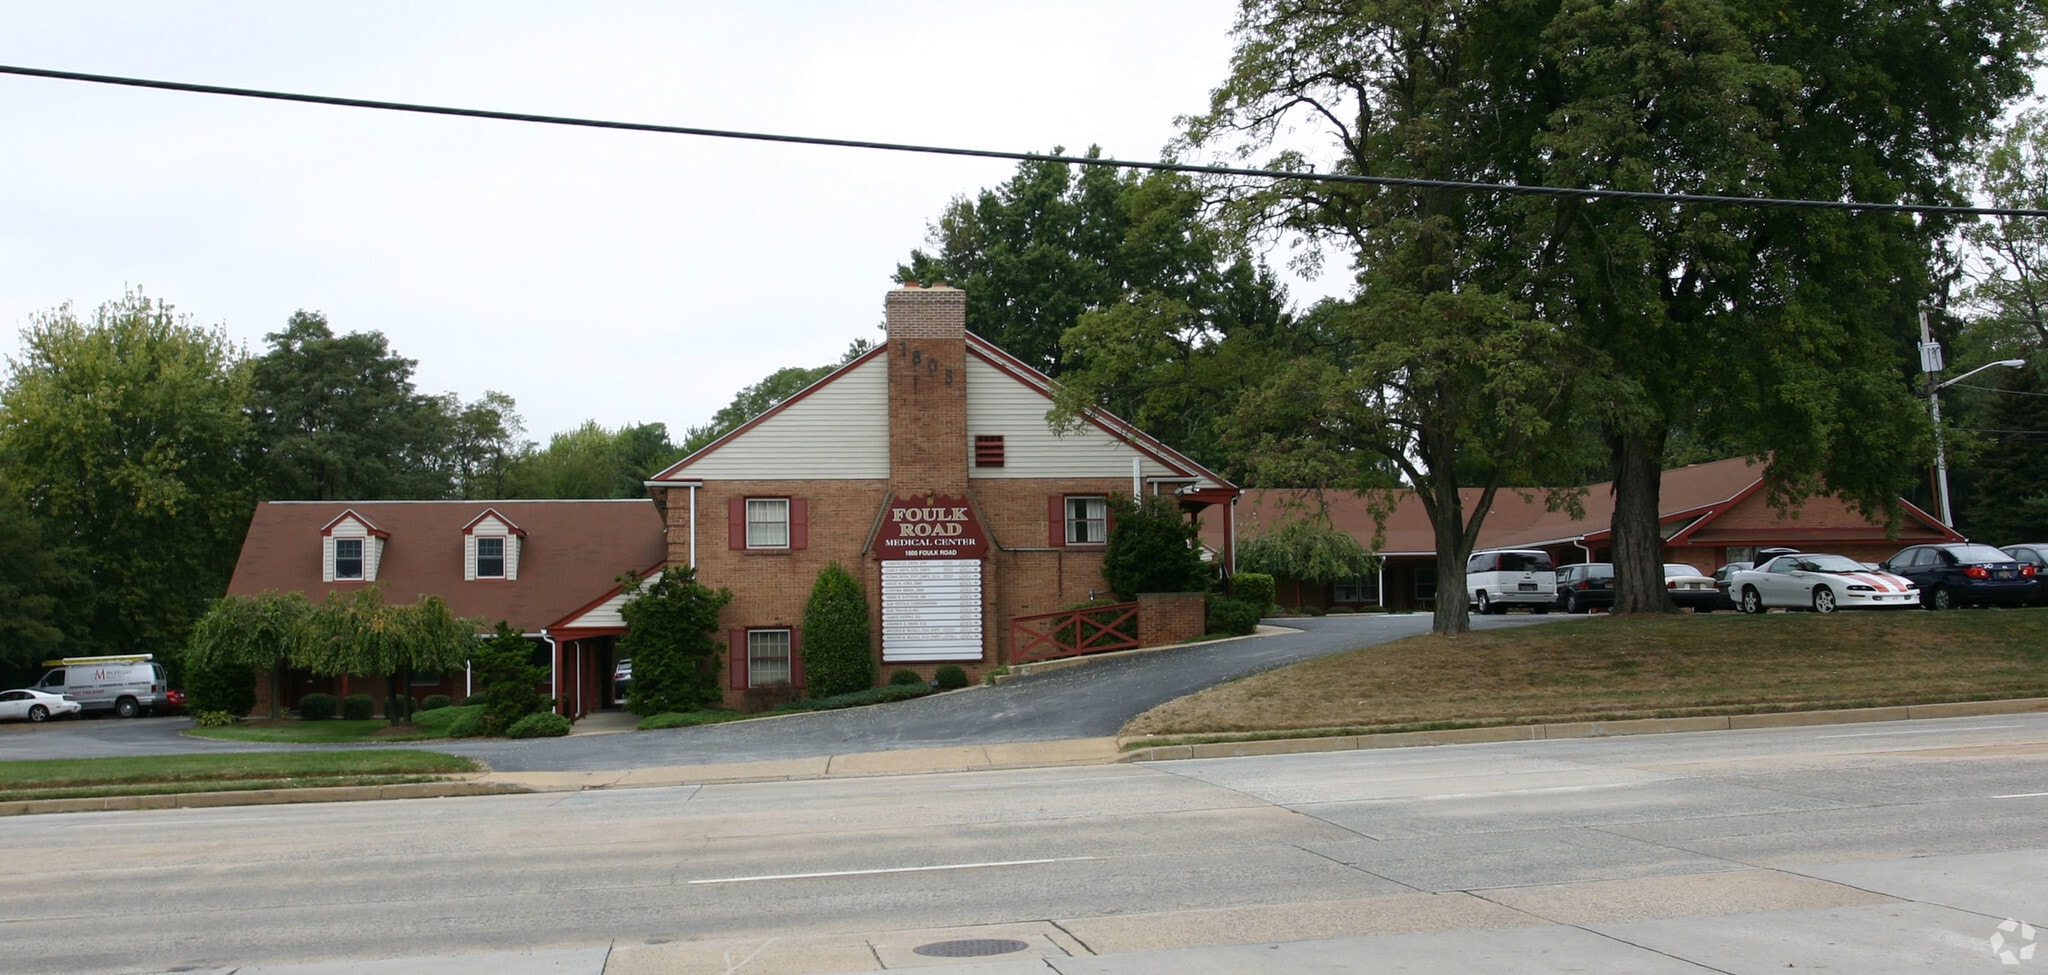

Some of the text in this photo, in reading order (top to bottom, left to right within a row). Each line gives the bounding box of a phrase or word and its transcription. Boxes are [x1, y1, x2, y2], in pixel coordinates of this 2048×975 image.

[899, 341, 953, 384] 1805
[892, 507, 969, 522] FOULK
[899, 523, 962, 536] ROAD
